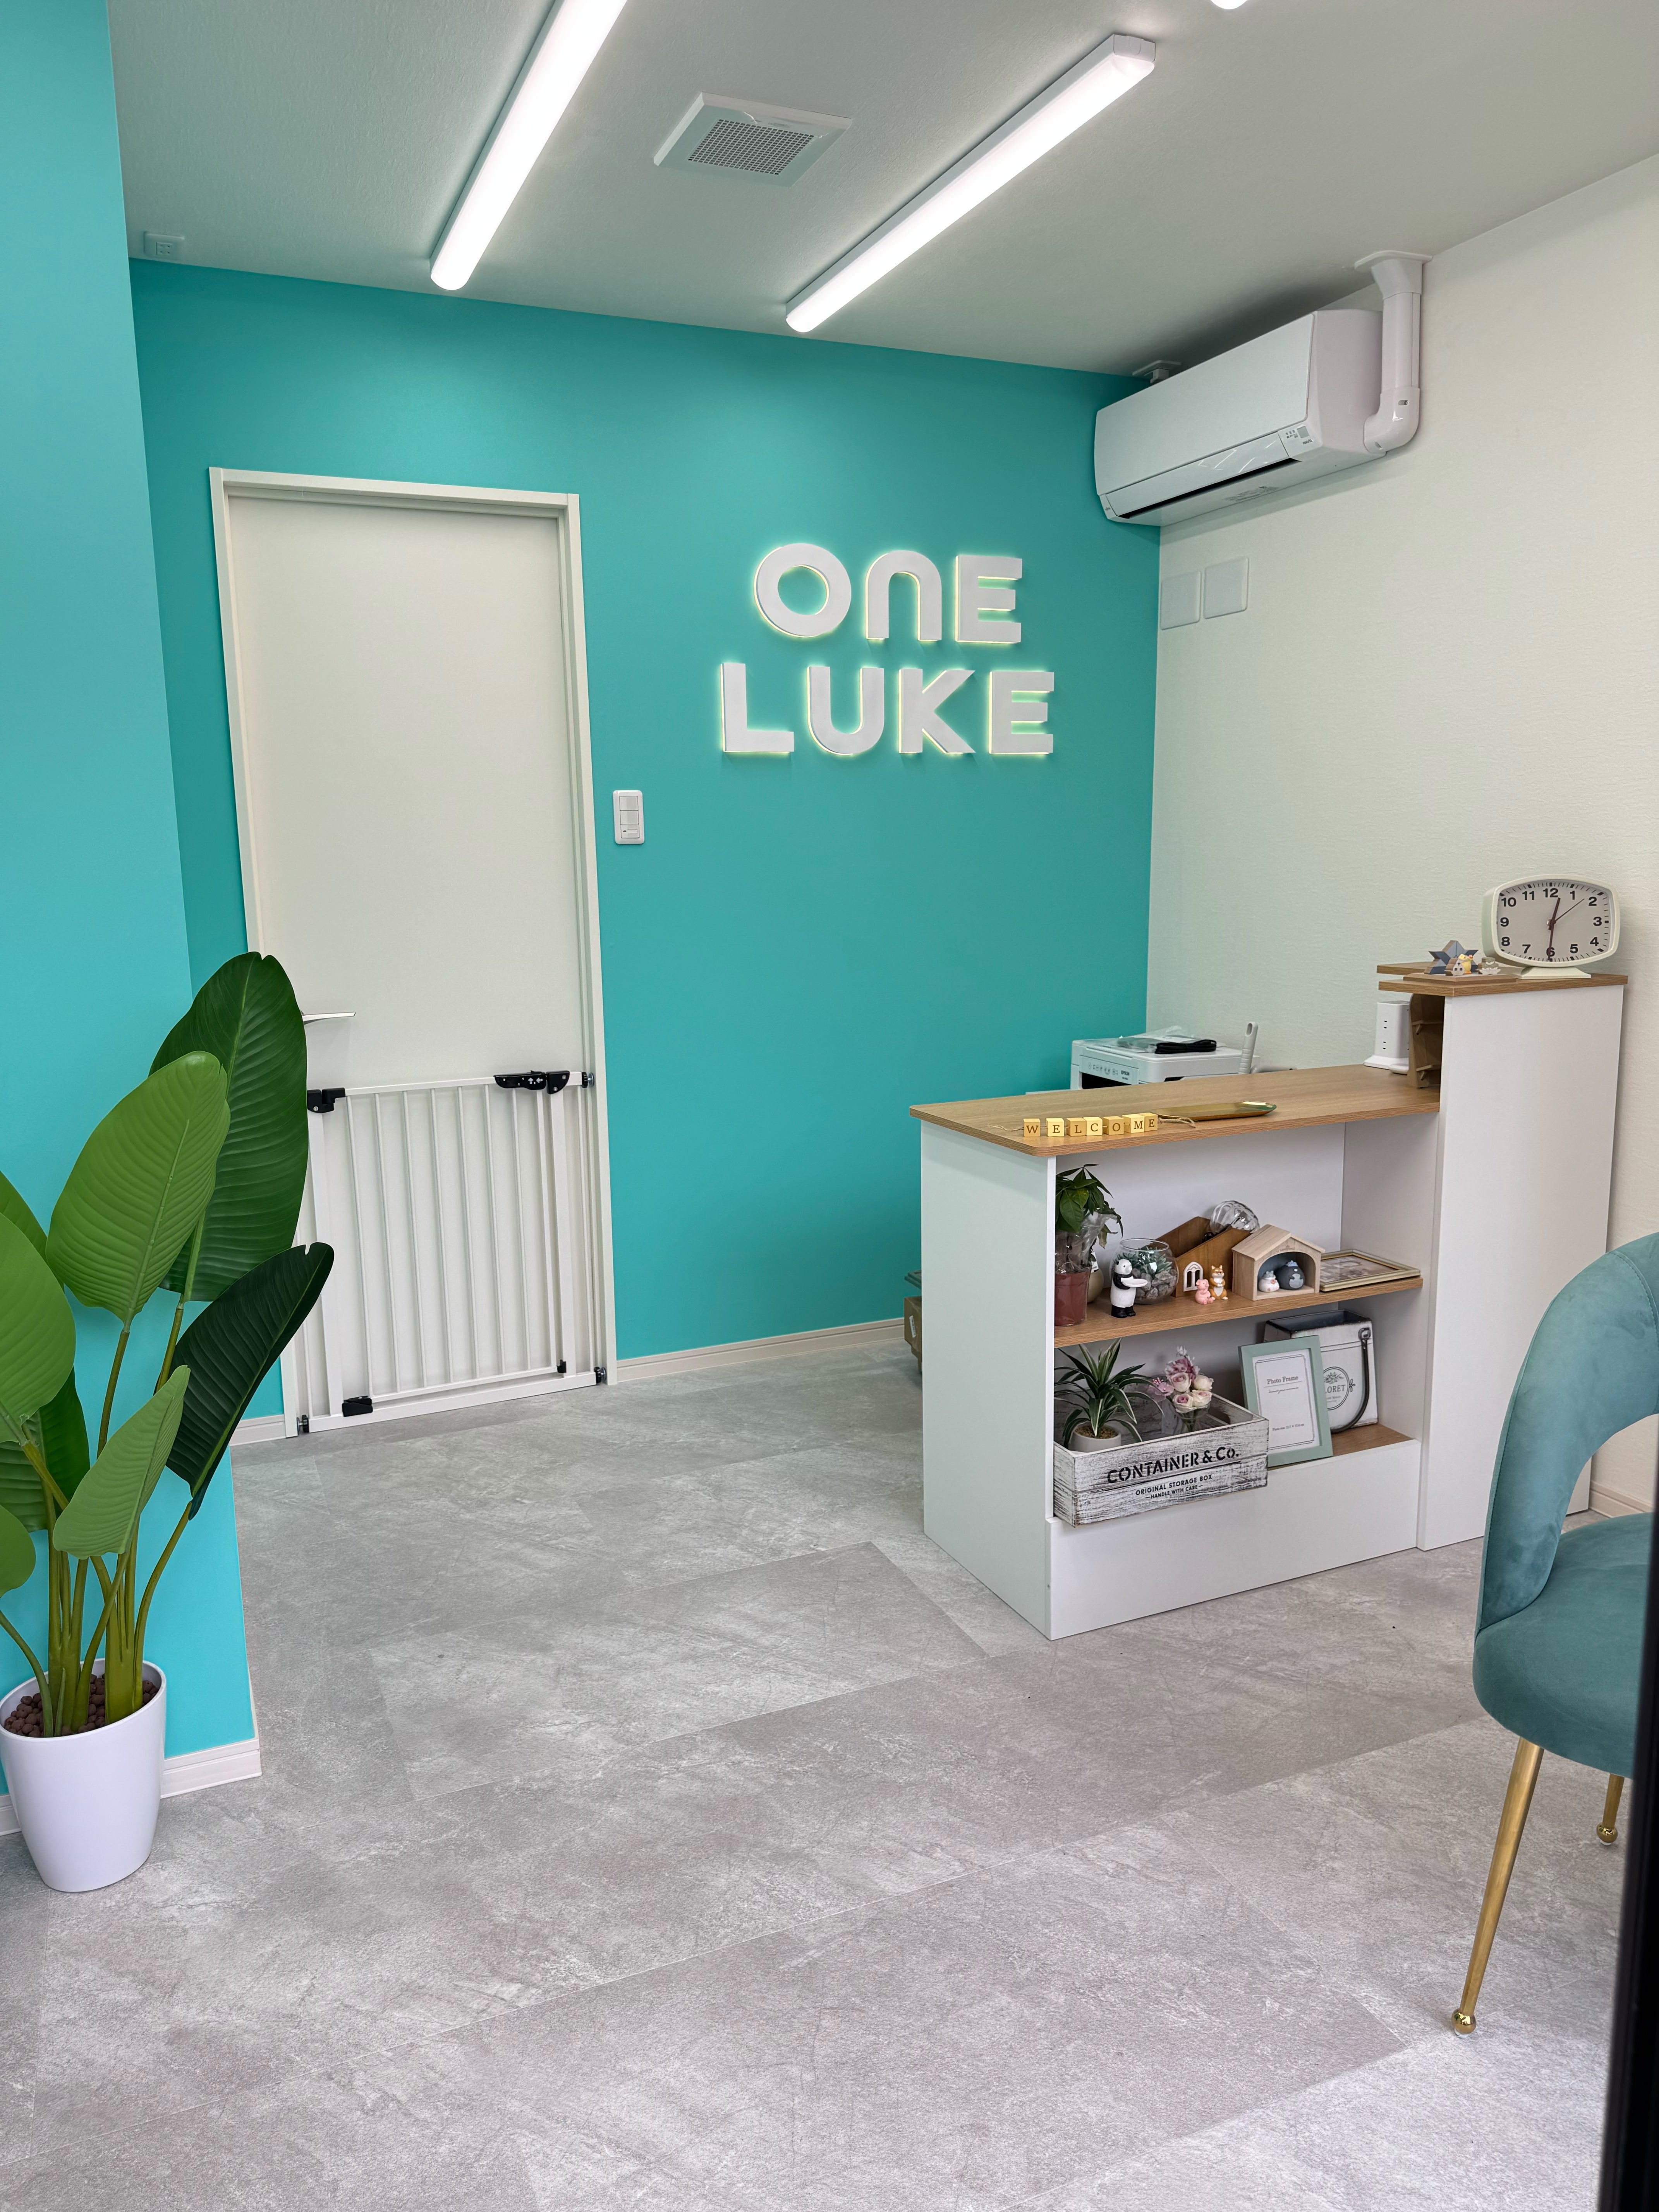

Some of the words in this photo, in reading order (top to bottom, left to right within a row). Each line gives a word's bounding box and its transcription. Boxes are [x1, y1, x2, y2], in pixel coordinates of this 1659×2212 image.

[754, 543, 1022, 644] ONE
[720, 663, 1054, 755] LUKE
[1522, 891, 1535, 900] 11
[1543, 888, 1558, 898] 12
[1570, 890, 1575, 900] 1
[1501, 897, 1517, 907] 10
[1589, 896, 1597, 906] 2
[1500, 917, 1509, 927] 9
[1593, 916, 1602, 926] 3
[1501, 936, 1510, 946] 8
[1590, 937, 1599, 946] 4
[1522, 944, 1531, 953] 7
[1546, 947, 1555, 957] 6
[1570, 944, 1578, 953] 5
[1026, 1119, 1155, 1133] WELCOME
[1325, 1384, 1346, 1394] ORET
[1107, 1452, 1199, 1484] CONTAINER
[1135, 1484, 1166, 1496] ORIGINAL
[1169, 1477, 1197, 1488] STORAGE
